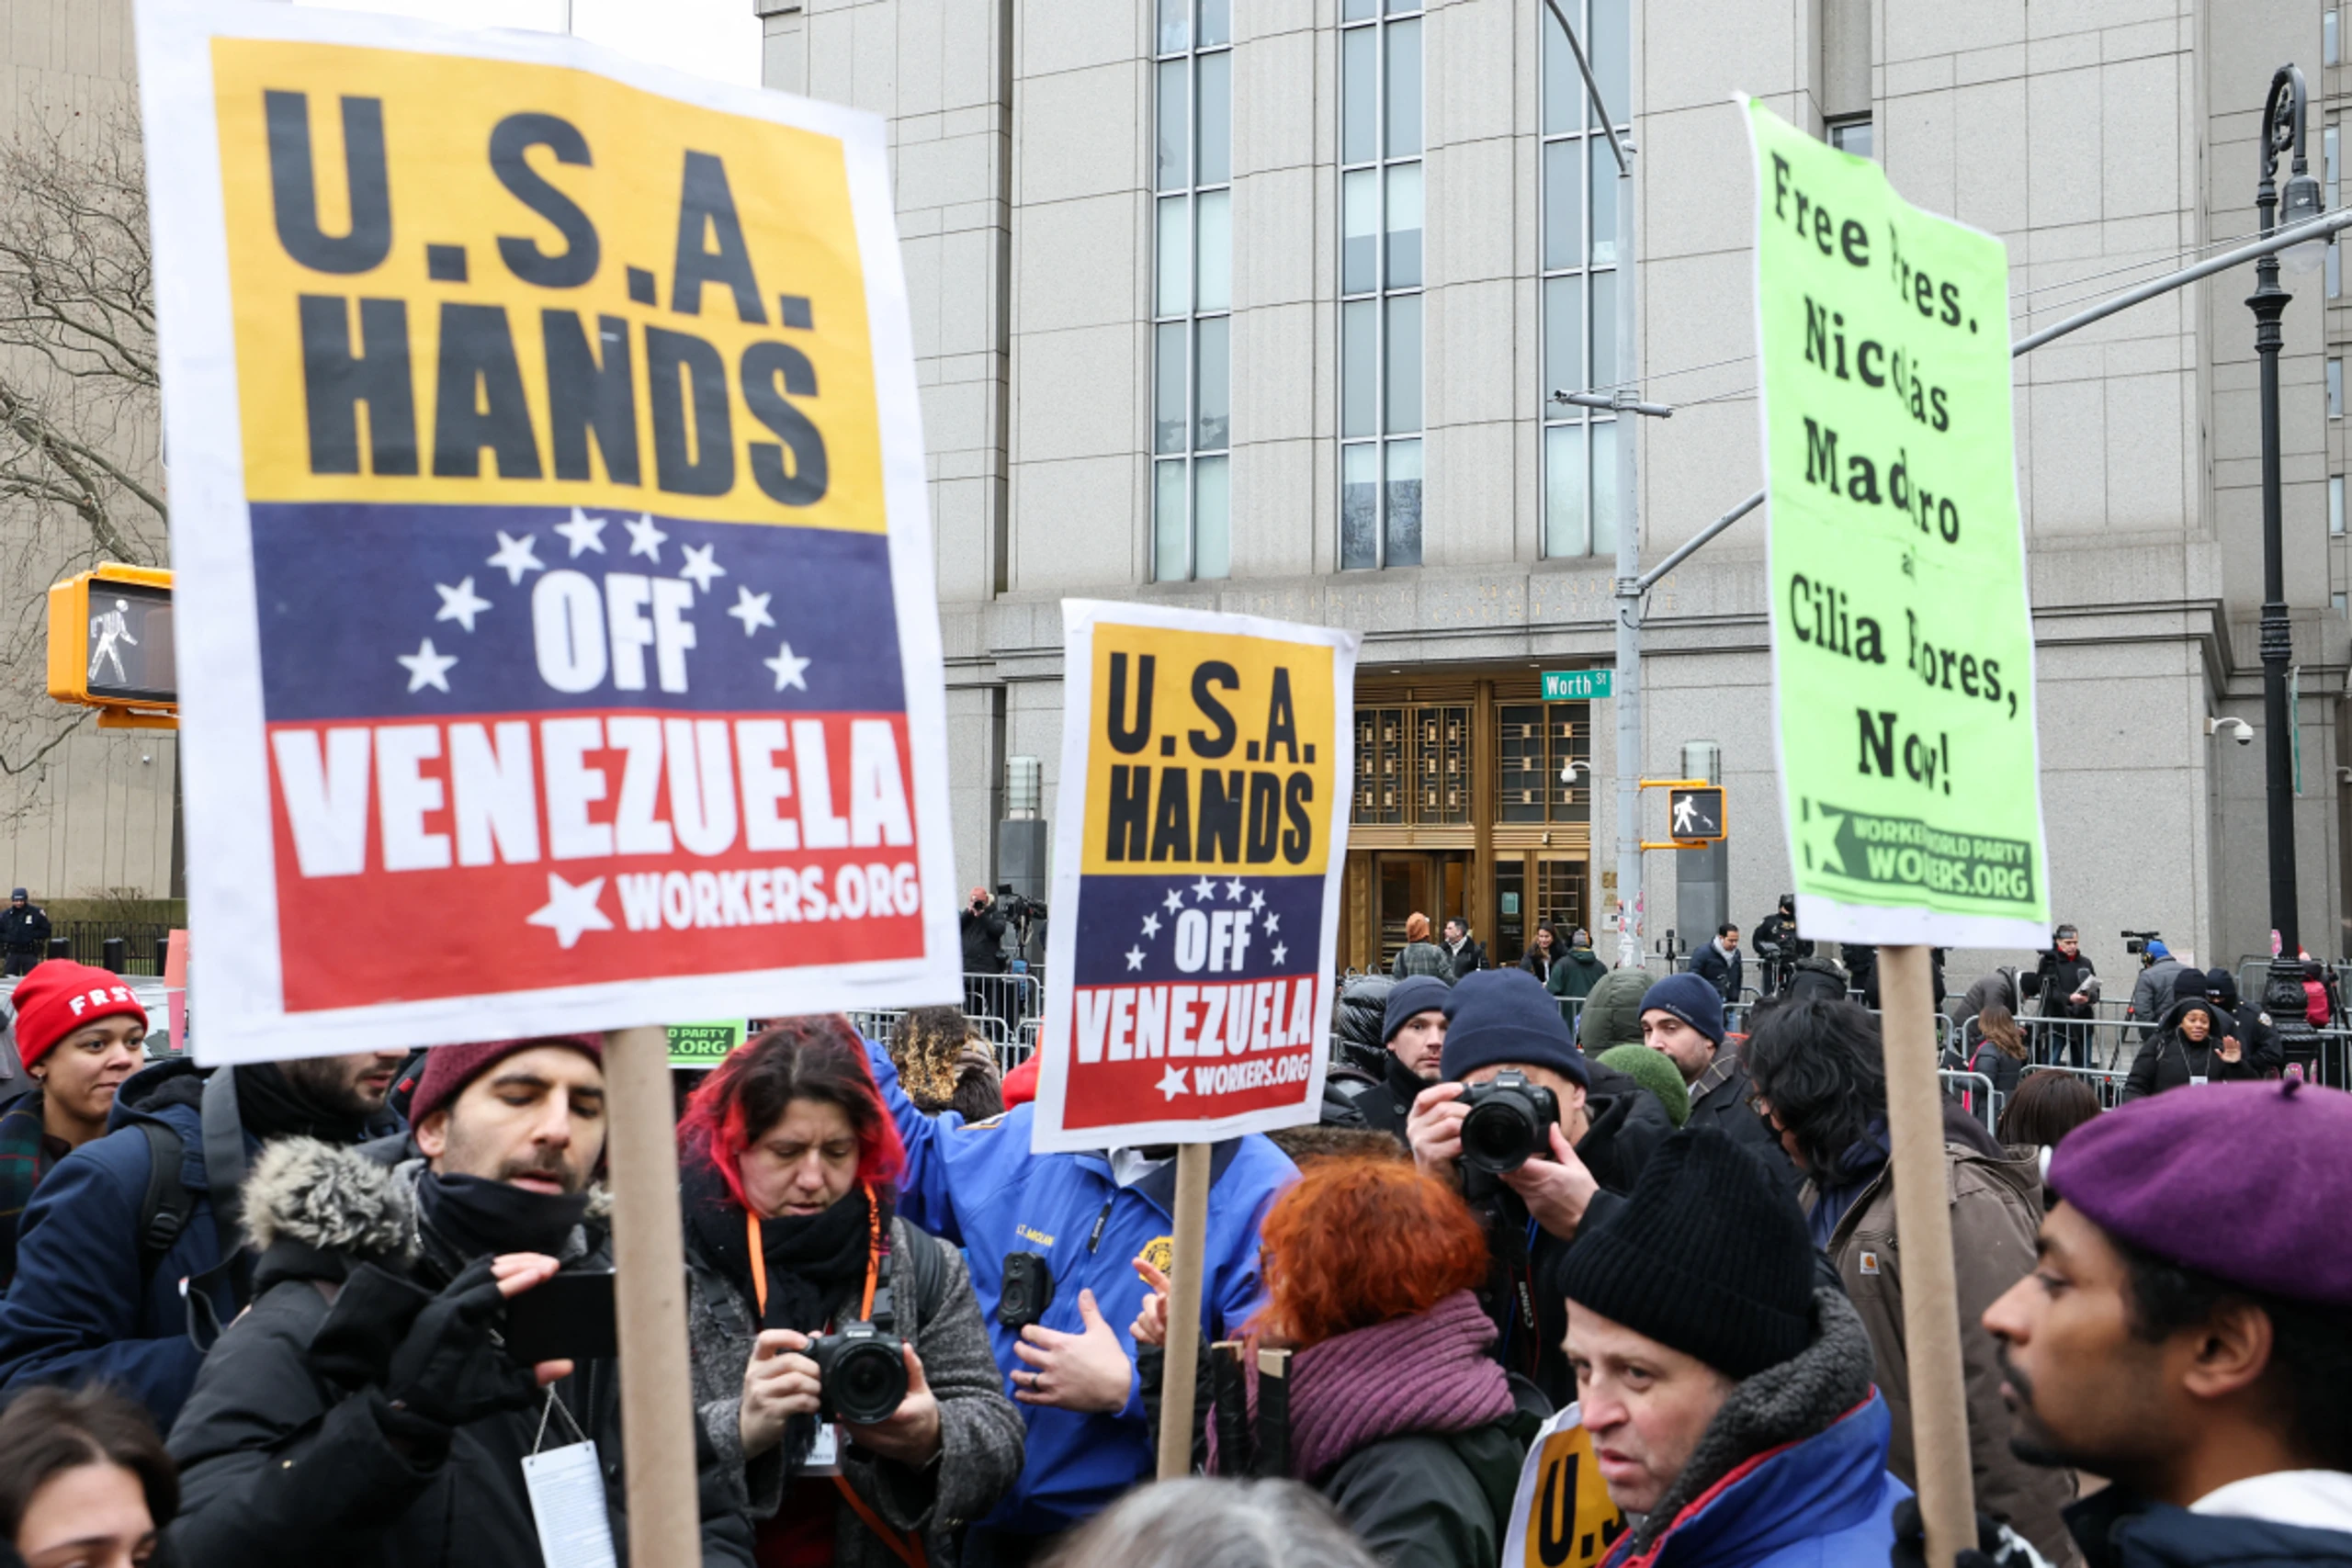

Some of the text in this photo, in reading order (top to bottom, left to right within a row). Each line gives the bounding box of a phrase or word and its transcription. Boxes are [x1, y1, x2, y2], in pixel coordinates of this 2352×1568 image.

[262, 86, 814, 330] U.S.A.
[1770, 149, 1870, 267] Free
[297, 292, 829, 506] HANDS
[531, 570, 696, 694] OFF
[1790, 572, 1886, 665] Cilia
[1107, 651, 1316, 764] U.S.A.
[1545, 674, 1592, 695] Worth
[271, 716, 913, 878] VENEZUELA
[1105, 763, 1313, 865] HANDS
[1973, 839, 2026, 863] PARTY
[615, 863, 919, 931] WORKERS.ORG
[1174, 908, 1253, 973] OFF
[68, 986, 141, 1016] FRS
[682, 1029, 728, 1038] PARTY
[1075, 976, 1313, 1064] VENEZUELA
[1193, 1053, 1311, 1096] WORKERS.ORG
